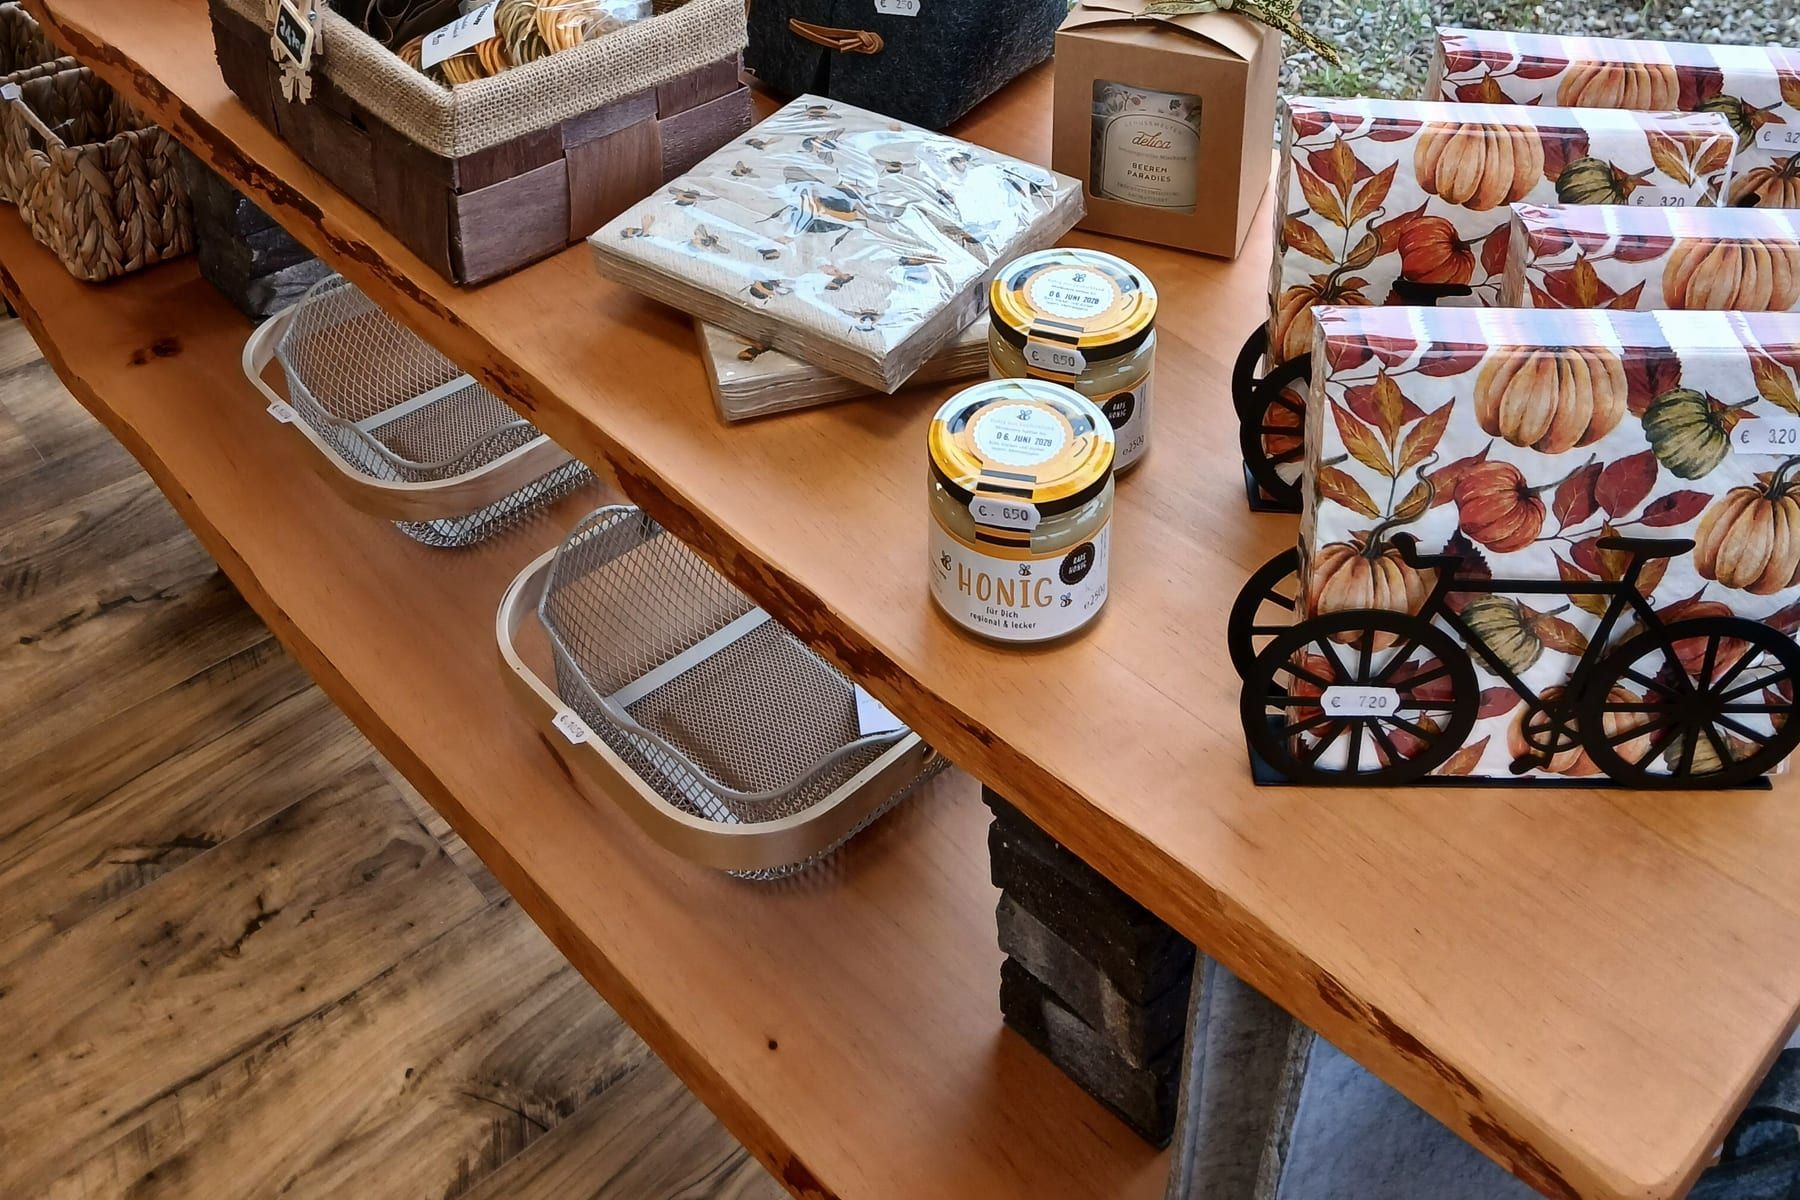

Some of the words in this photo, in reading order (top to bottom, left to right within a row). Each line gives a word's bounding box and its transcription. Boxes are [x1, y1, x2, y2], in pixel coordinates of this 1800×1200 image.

[1132, 162, 1168, 174] BEEREN
[1127, 171, 1172, 183] PARADIES
[1064, 293, 1081, 302] JUNI
[1014, 434, 1032, 443] JUNI
[1740, 430, 1750, 444] €
[958, 562, 1053, 609] HONIG
[986, 605, 998, 617] für
[1000, 609, 1019, 620] Dich
[969, 612, 1001, 628] regional
[1003, 620, 1009, 629] &
[1011, 621, 1037, 630] lecker
